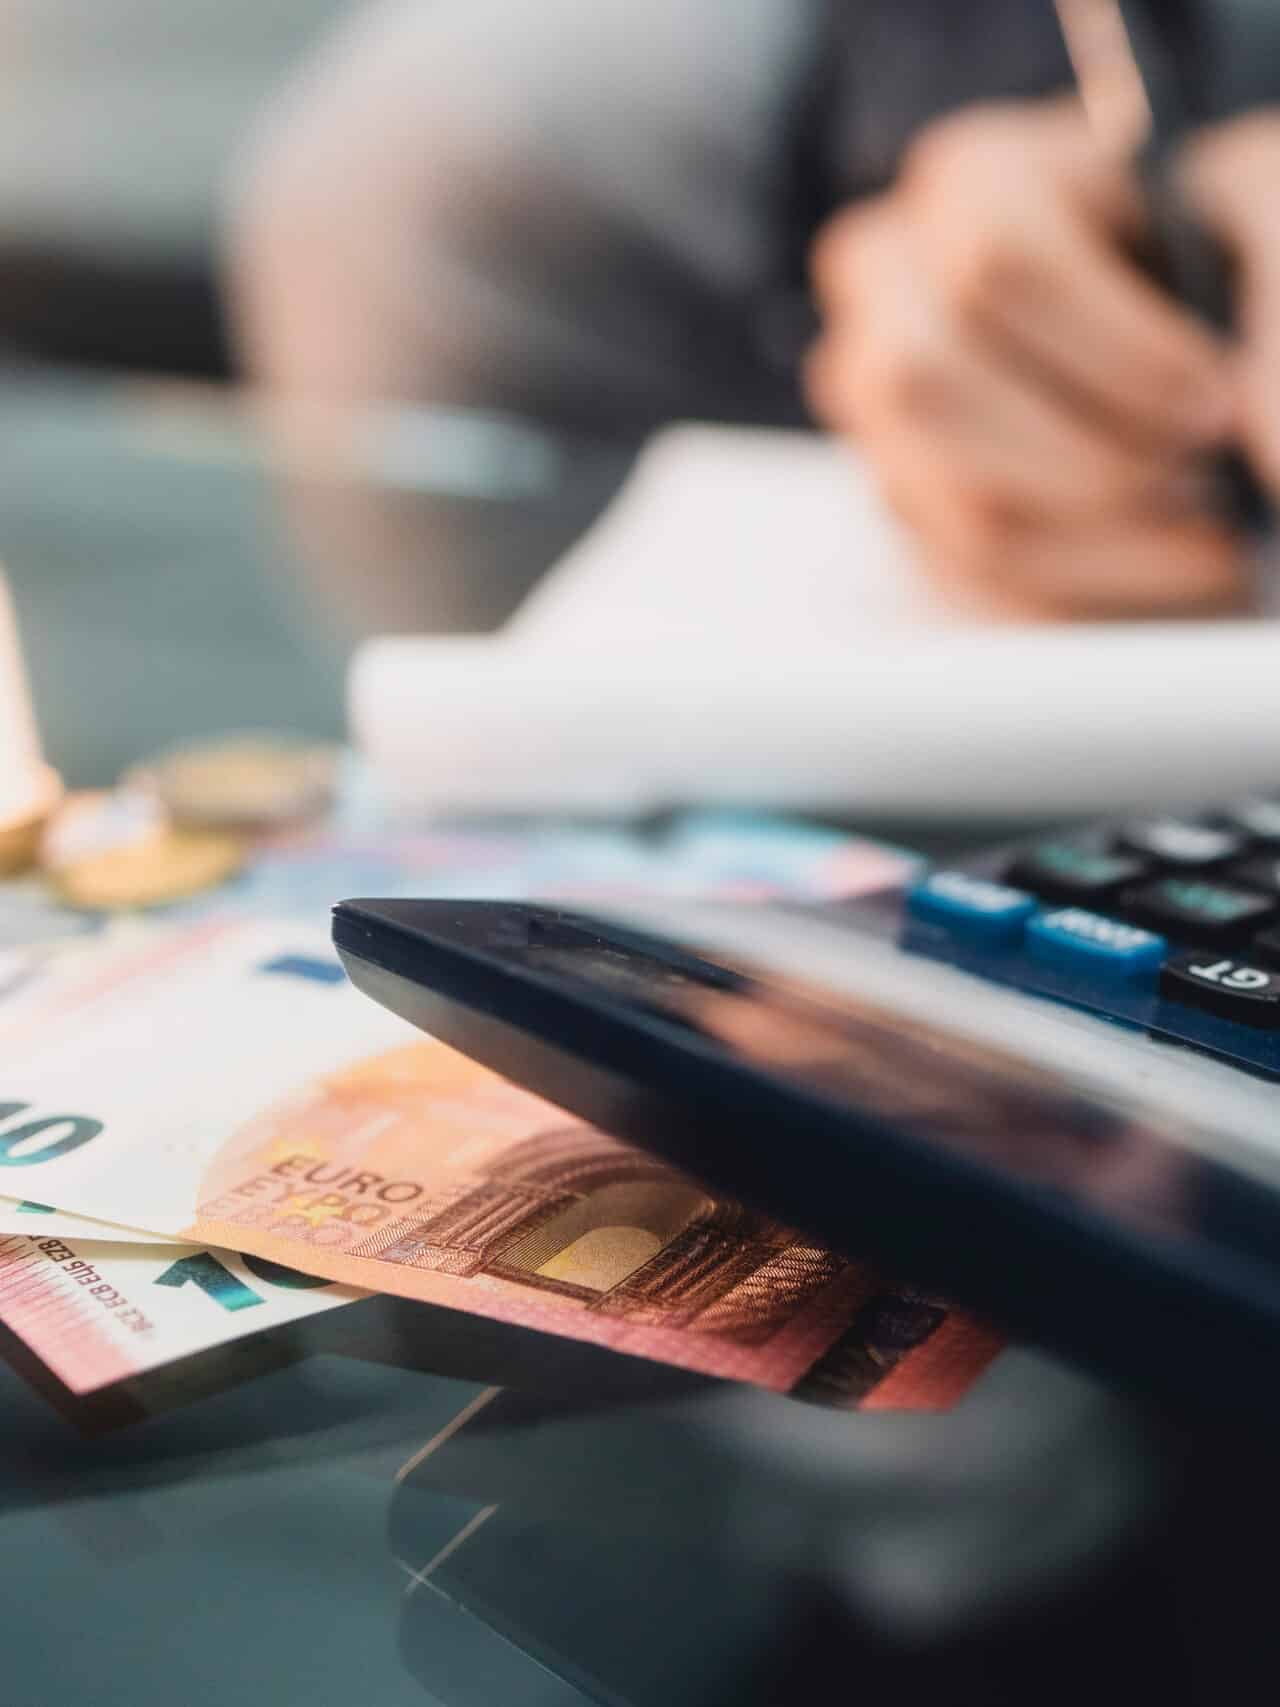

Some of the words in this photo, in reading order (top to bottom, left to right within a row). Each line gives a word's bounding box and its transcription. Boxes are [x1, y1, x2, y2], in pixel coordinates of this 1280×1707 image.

[1188, 960, 1270, 989] GT
[272, 1154, 423, 1203] EURO
[39, 1239, 74, 1263] EZB
[88, 1281, 127, 1310] ECB
